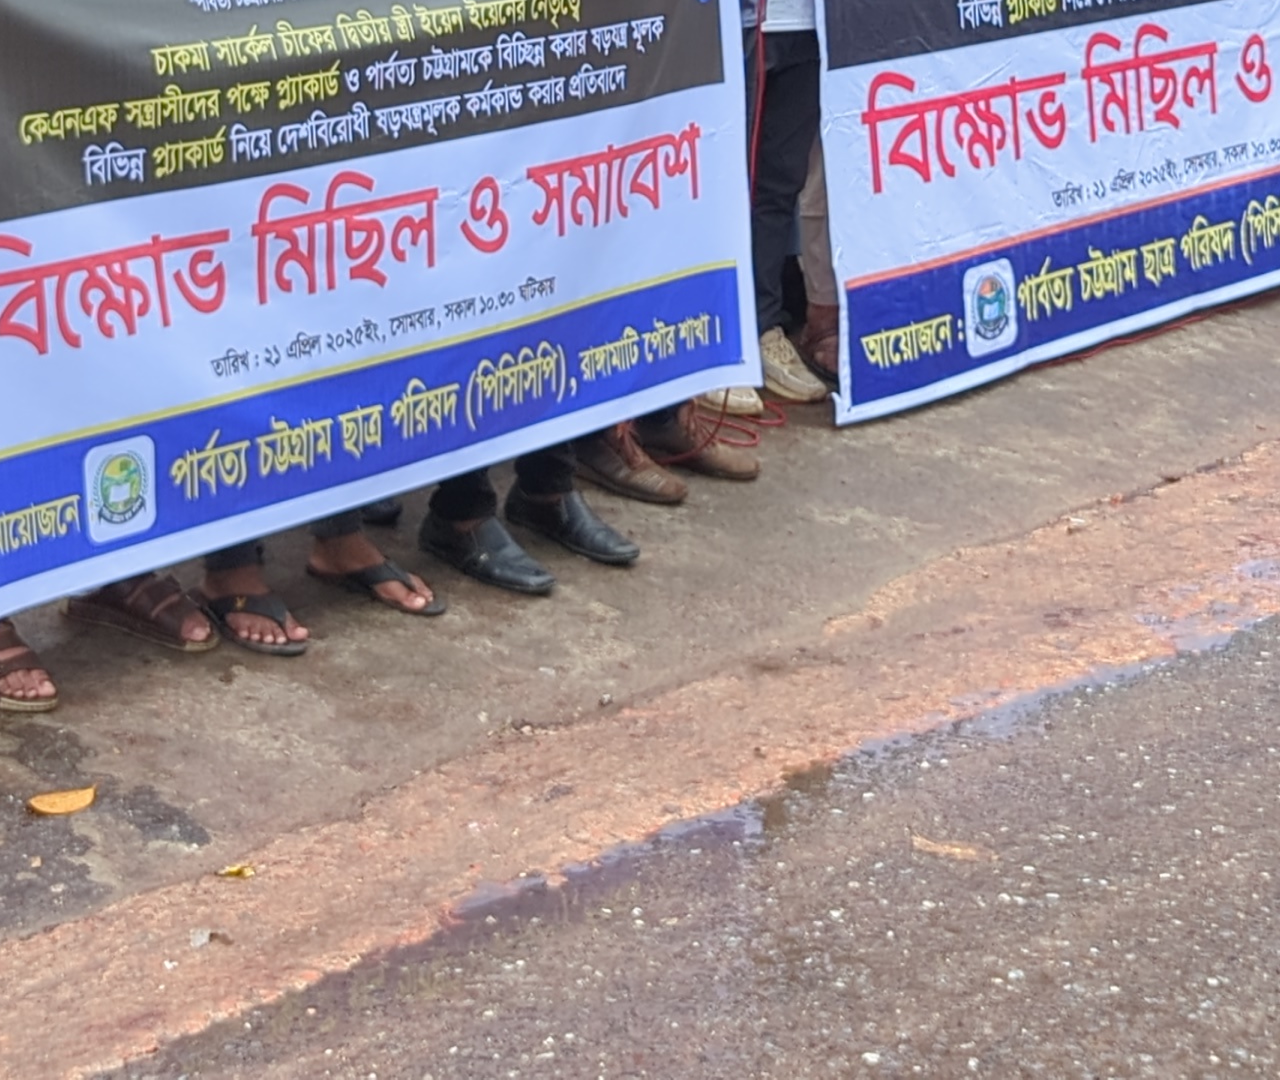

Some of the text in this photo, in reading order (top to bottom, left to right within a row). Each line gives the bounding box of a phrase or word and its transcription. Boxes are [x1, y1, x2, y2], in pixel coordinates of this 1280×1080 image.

[20, 103, 119, 145] কেএনএফ
[124, 83, 221, 130] সন্ত্রাসীদের
[226, 80, 271, 113] পক্ষে
[276, 59, 342, 111] প্ল্যাকার্ড
[345, 68, 360, 94] ও
[365, 51, 418, 91] পার্বত্য
[421, 44, 493, 81] চট্টগ্রামকে
[496, 31, 545, 71] বিচ্ছিন্ন
[549, 34, 587, 60] করার
[631, 14, 665, 53] মূলক
[151, 41, 211, 77] চাকমা
[213, 24, 275, 67] সার্কেল
[277, 20, 337, 57] চীফের
[337, 8, 392, 51] দ্বিতীয়
[393, 4, 416, 43] স্ত্রী
[416, 1, 464, 37] ইয়েন
[861, 70, 1067, 194] বিক্ষোভ
[1081, 22, 1219, 144] মিছিল
[1234, 33, 1272, 104] ও
[83, 142, 146, 186] বিভিন্ন
[152, 125, 227, 178] প্ল্যাকার্ড
[229, 121, 273, 163] নিয়ে
[277, 101, 371, 155] দেশবিরোধী
[526, 76, 565, 106] করার
[569, 64, 627, 100] প্রতিবাদে
[251, 169, 440, 305] মিছিল
[459, 175, 510, 255] ও
[526, 123, 703, 238] সমাবেশ
[211, 348, 250, 378] তারিখ
[264, 344, 282, 367] ২১
[285, 331, 322, 360] এপ্রিল
[444, 296, 477, 322] সকাল
[479, 289, 516, 314] ১০.৩০
[519, 274, 556, 302] ঘটিকায়
[860, 313, 953, 370] আয়োজনে
[1017, 256, 1074, 322] পার্বত্য
[1077, 244, 1138, 302] চট্টগ্রাম
[1140, 237, 1176, 287] ছাত্র
[1180, 214, 1236, 271] পরিষদ
[170, 429, 251, 501] পার্বত্য
[256, 414, 335, 478] চট্টগ্রাম
[337, 402, 384, 459] ছাত্র
[389, 377, 460, 443] পরিষদ
[579, 331, 640, 383] রাঙ্গামাটি
[644, 318, 677, 364] পৌর
[679, 311, 712, 353] শাখা
